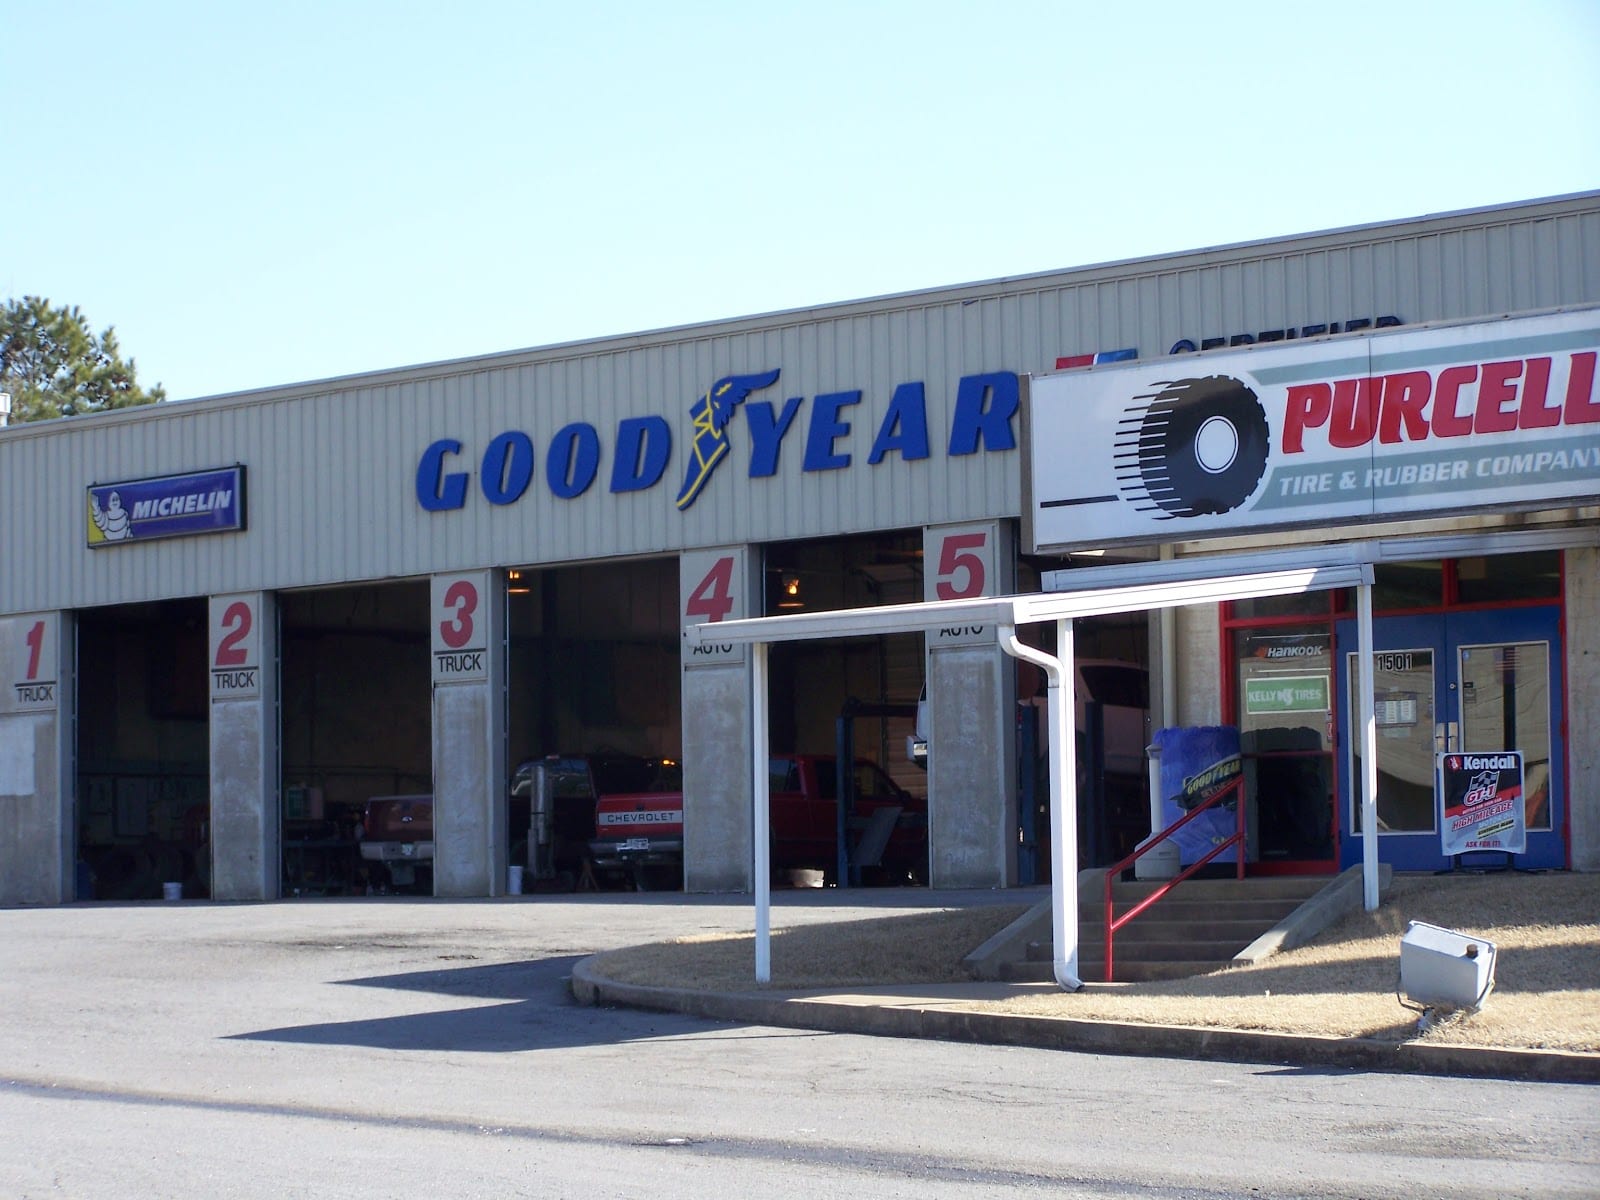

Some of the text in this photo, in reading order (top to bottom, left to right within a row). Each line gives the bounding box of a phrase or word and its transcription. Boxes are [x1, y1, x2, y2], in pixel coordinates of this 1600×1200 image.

[1282, 352, 1600, 454] PURCELL
[415, 369, 1022, 512] GOODYEAR
[1280, 447, 1600, 496] TIRE & RUBBER COMPANY
[132, 490, 232, 520] MICHELIN
[936, 533, 987, 600] 5
[686, 557, 734, 623] 4
[215, 601, 252, 666] 2
[440, 580, 478, 649] 3
[26, 620, 45, 681] 1
[437, 653, 482, 673] TRUCK
[1377, 653, 1413, 672] 1501
[16, 686, 53, 703] TRUCK
[215, 671, 255, 689] TRUCK
[1248, 690, 1277, 703] KELLY
[1295, 688, 1322, 702] TIRES
[1463, 755, 1515, 770] Kendall
[607, 812, 675, 823] CHEVROLET
